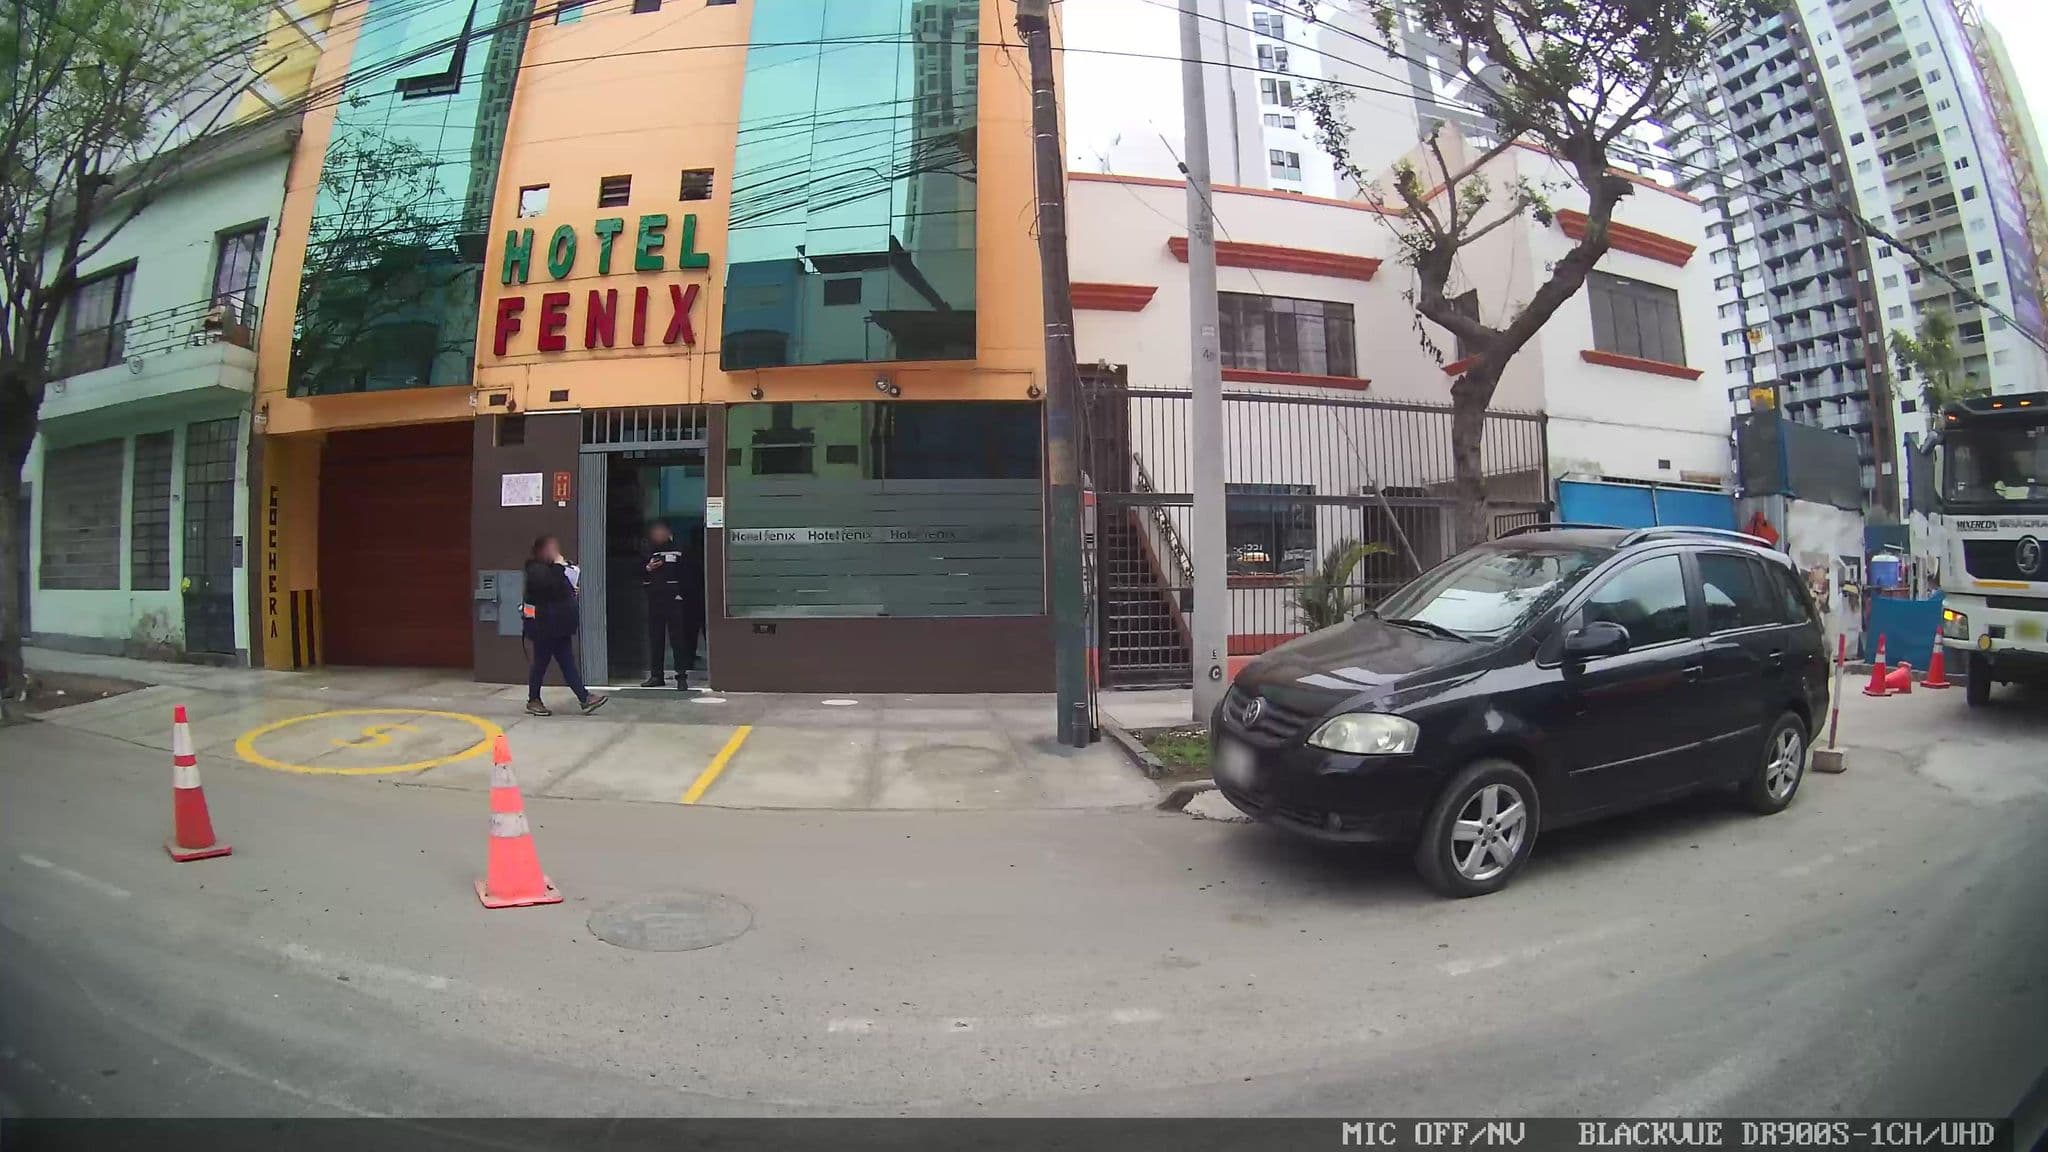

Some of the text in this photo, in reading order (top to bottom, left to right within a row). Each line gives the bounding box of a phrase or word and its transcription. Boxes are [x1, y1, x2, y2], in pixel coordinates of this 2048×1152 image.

[502, 214, 709, 285] HOTEL
[493, 284, 700, 356] FENIX
[808, 530, 839, 542] Hotel
